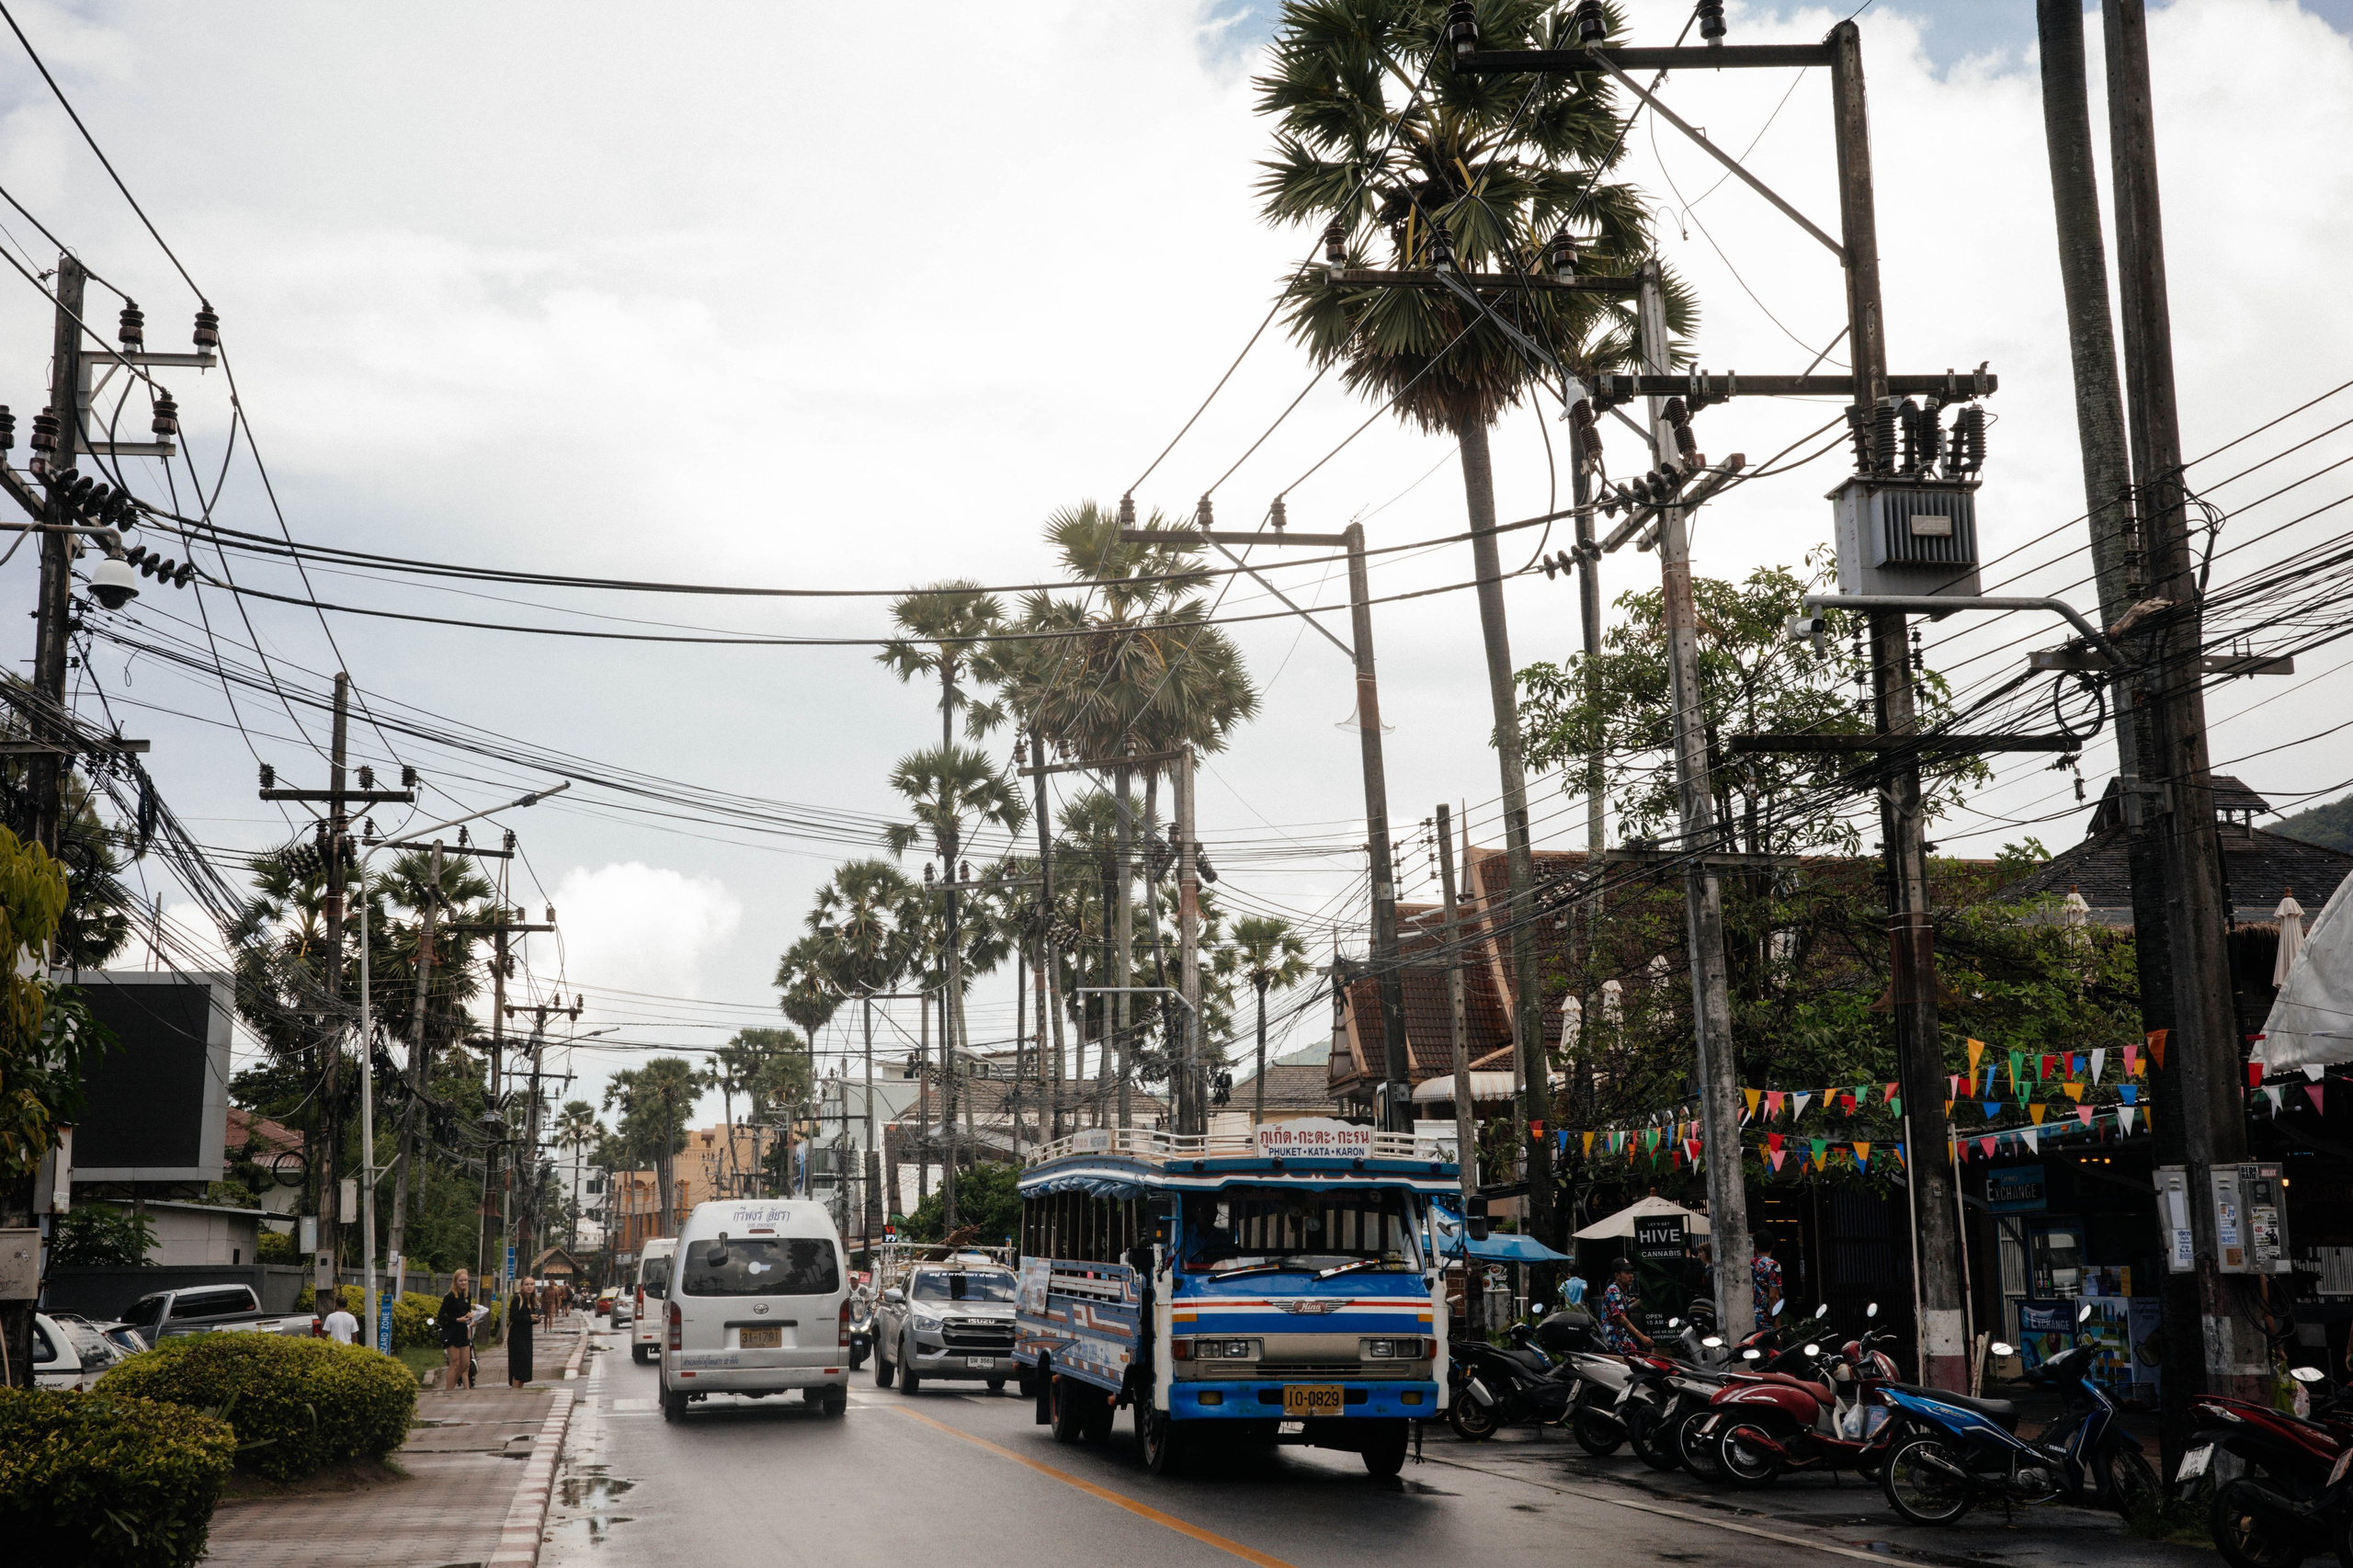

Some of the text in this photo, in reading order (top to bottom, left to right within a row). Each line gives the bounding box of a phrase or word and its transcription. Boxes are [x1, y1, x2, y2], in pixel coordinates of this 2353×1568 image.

[1260, 1126, 1370, 1149] ภูเก็ต กะตะ กะรน
[1268, 1147, 1365, 1156] PHUKET KATA KARON
[1985, 1179, 2037, 1202] EXCHANGE
[1639, 1228, 1681, 1244] HIVE
[1641, 1250, 1682, 1258] CANNABIS
[1299, 1301, 1322, 1312] Hino
[381, 1312, 390, 1331] ZONE
[2030, 1312, 2071, 1331] EXCHANGE
[742, 1332, 779, 1343] 31-1791
[1289, 1391, 1339, 1407] 10-0829
[2048, 1444, 2067, 1454] YAMAHA
